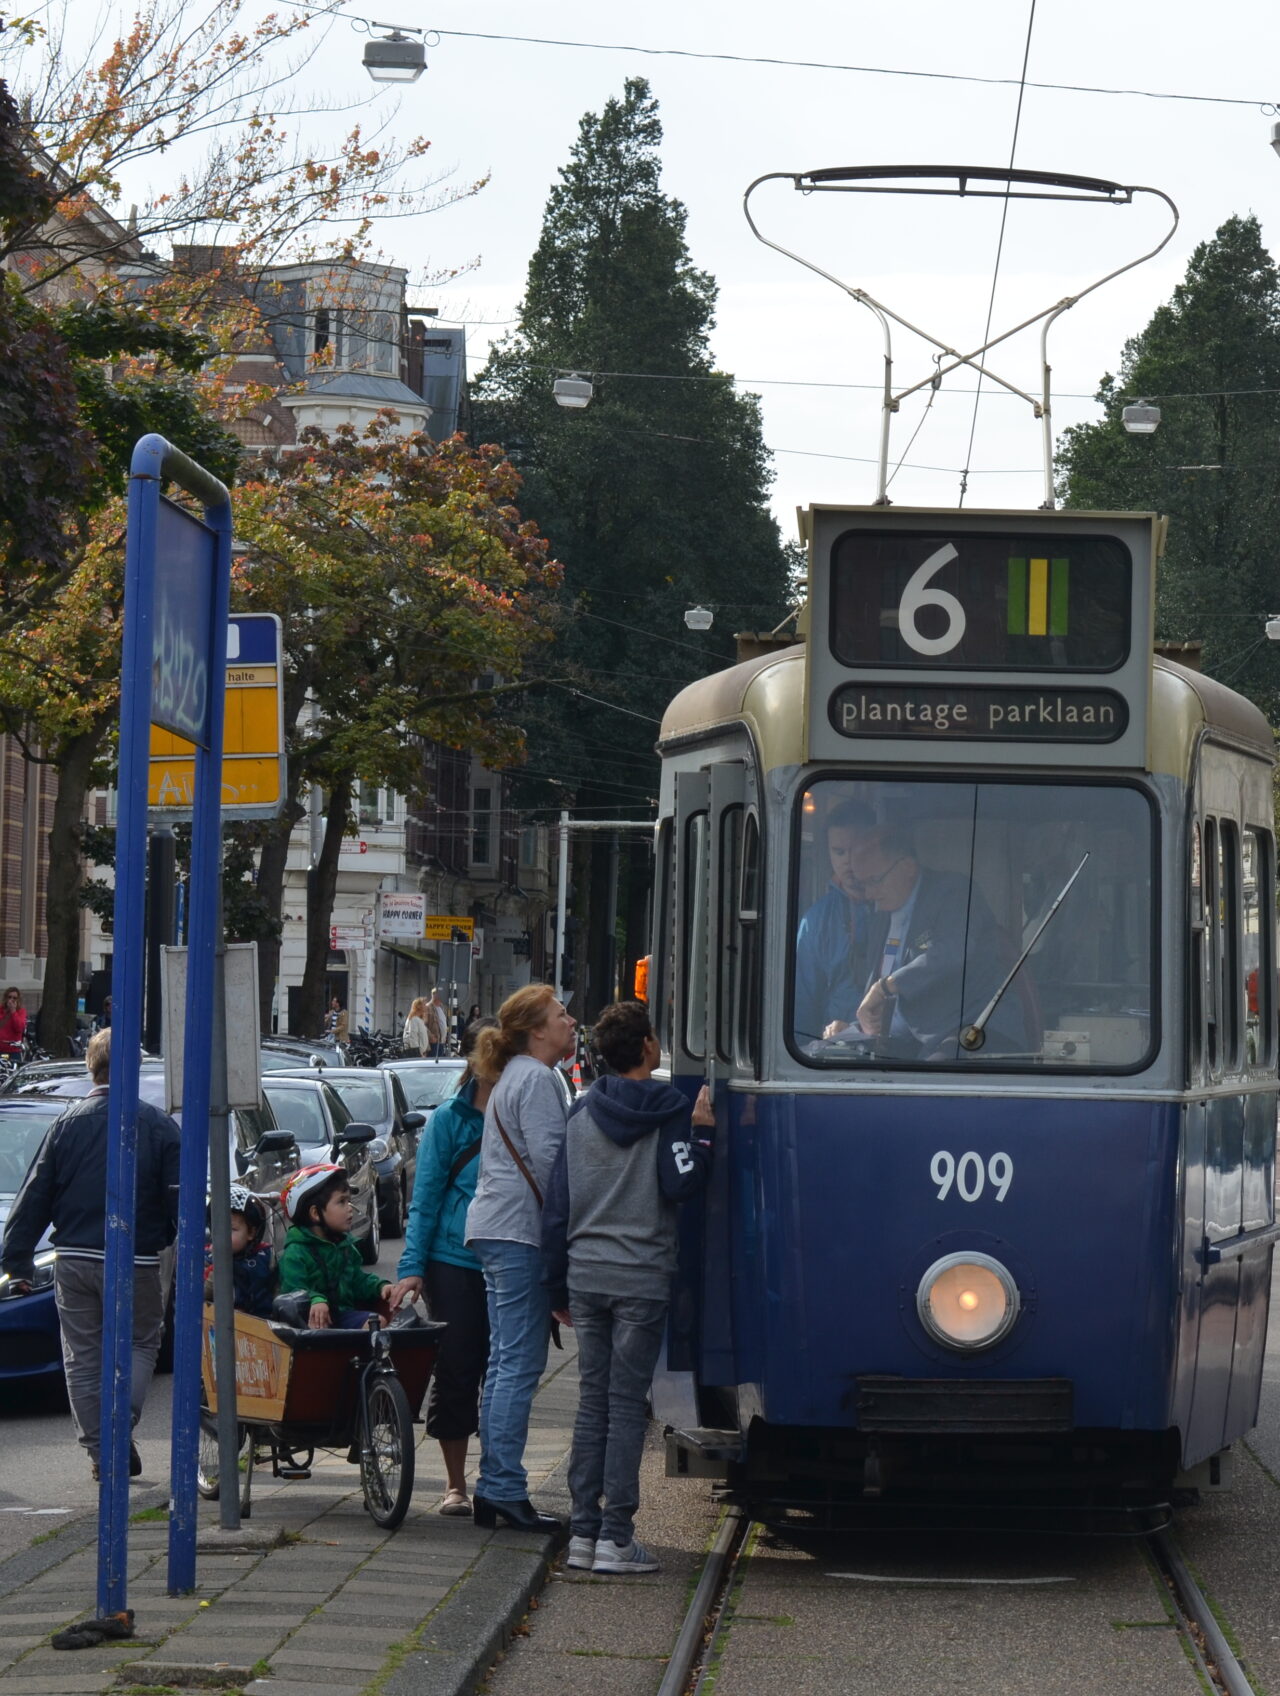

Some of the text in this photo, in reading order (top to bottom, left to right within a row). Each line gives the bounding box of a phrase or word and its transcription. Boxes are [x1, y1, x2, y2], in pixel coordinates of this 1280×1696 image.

[898, 541, 967, 656] 6
[228, 672, 255, 682] halte
[842, 695, 1114, 730] plantage parklaan
[382, 909, 400, 920] HAPPY
[401, 910, 423, 920] CORNER
[672, 1141, 694, 1174] 2
[929, 1150, 1014, 1203] 909
